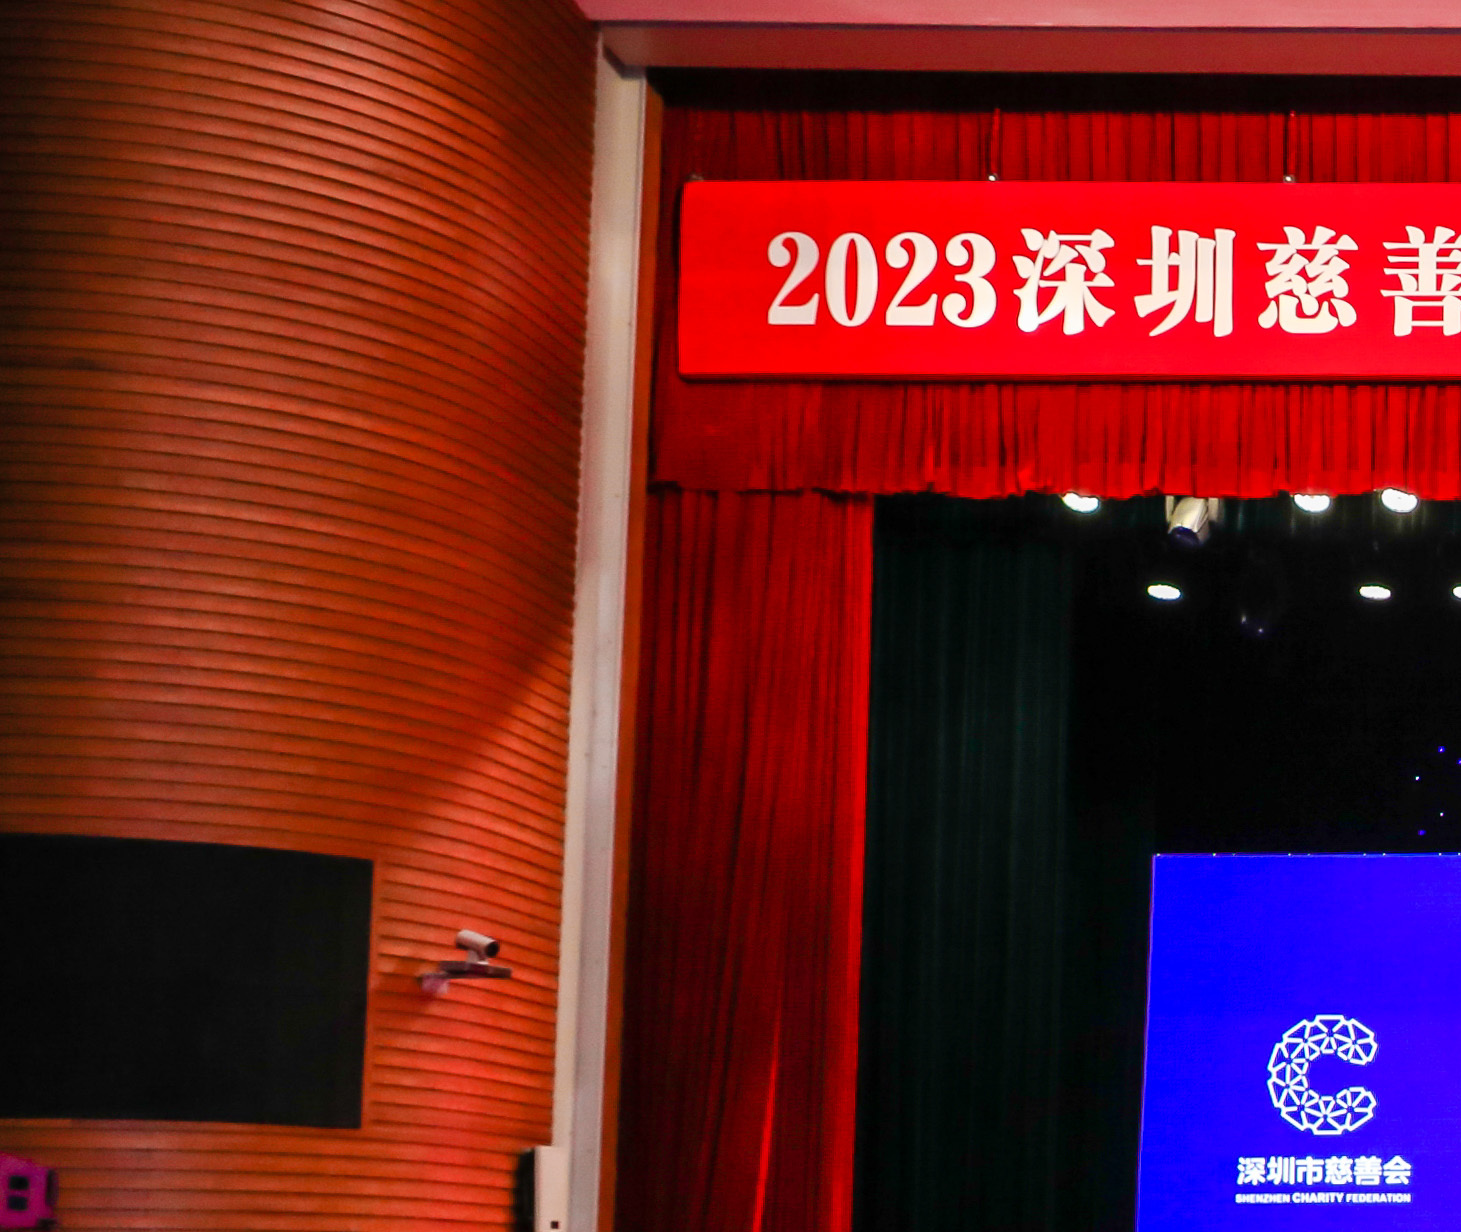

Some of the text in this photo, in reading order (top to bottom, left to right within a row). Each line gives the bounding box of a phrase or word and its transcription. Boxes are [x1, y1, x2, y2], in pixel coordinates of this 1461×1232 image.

[1236, 1155, 1412, 1186] 深圳市慈善会
[1235, 1191, 1412, 1204] SHENZHEN CHARITY FEDERATION
